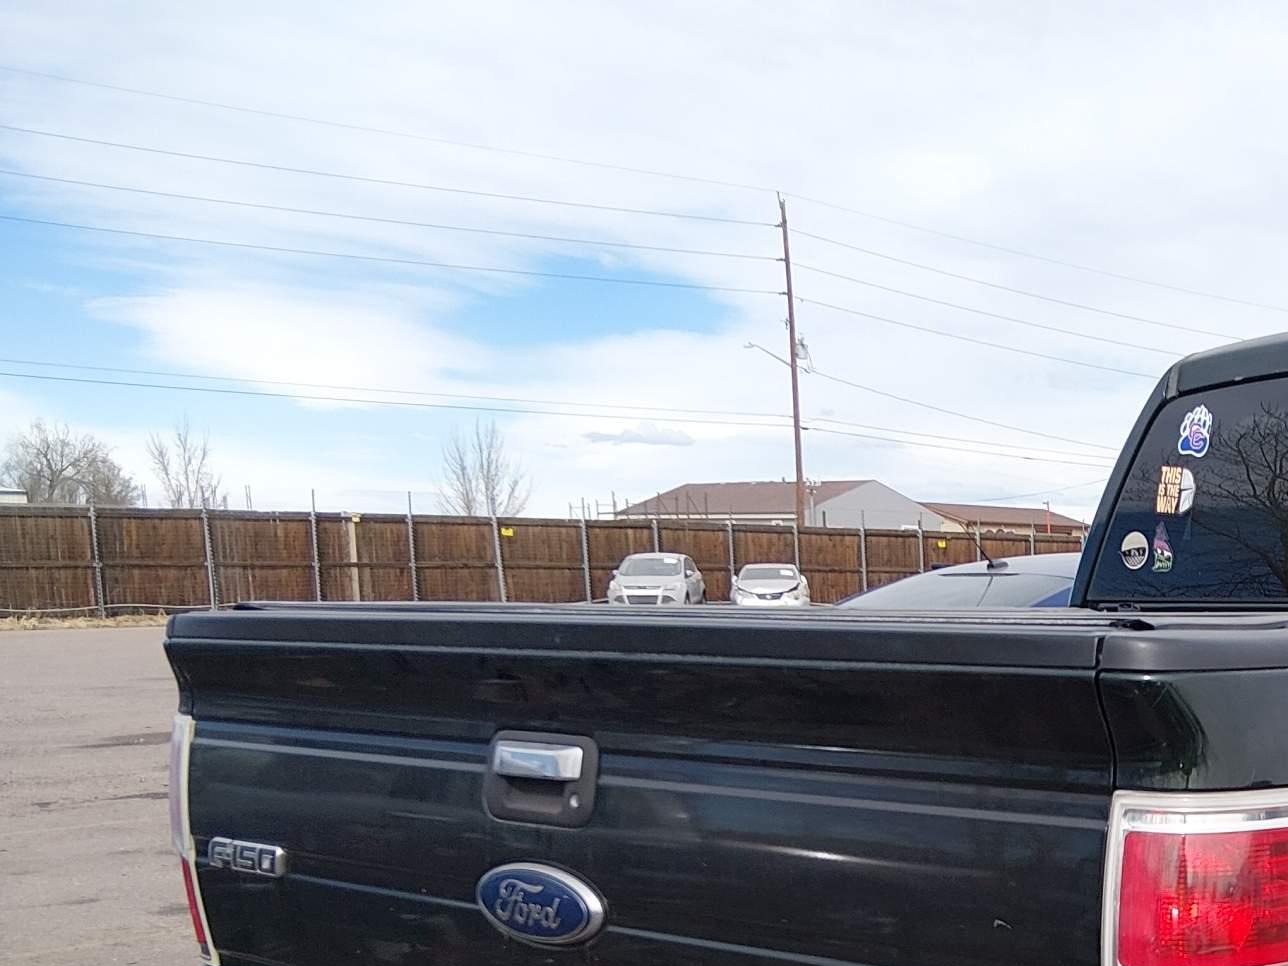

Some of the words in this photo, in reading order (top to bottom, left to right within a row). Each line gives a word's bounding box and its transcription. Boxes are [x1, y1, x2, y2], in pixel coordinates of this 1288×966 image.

[1160, 465, 1182, 484] THIS
[1158, 483, 1167, 497] IS
[1166, 484, 1180, 498] THE
[1156, 496, 1179, 514] WAY
[495, 878, 562, 929] Ford
